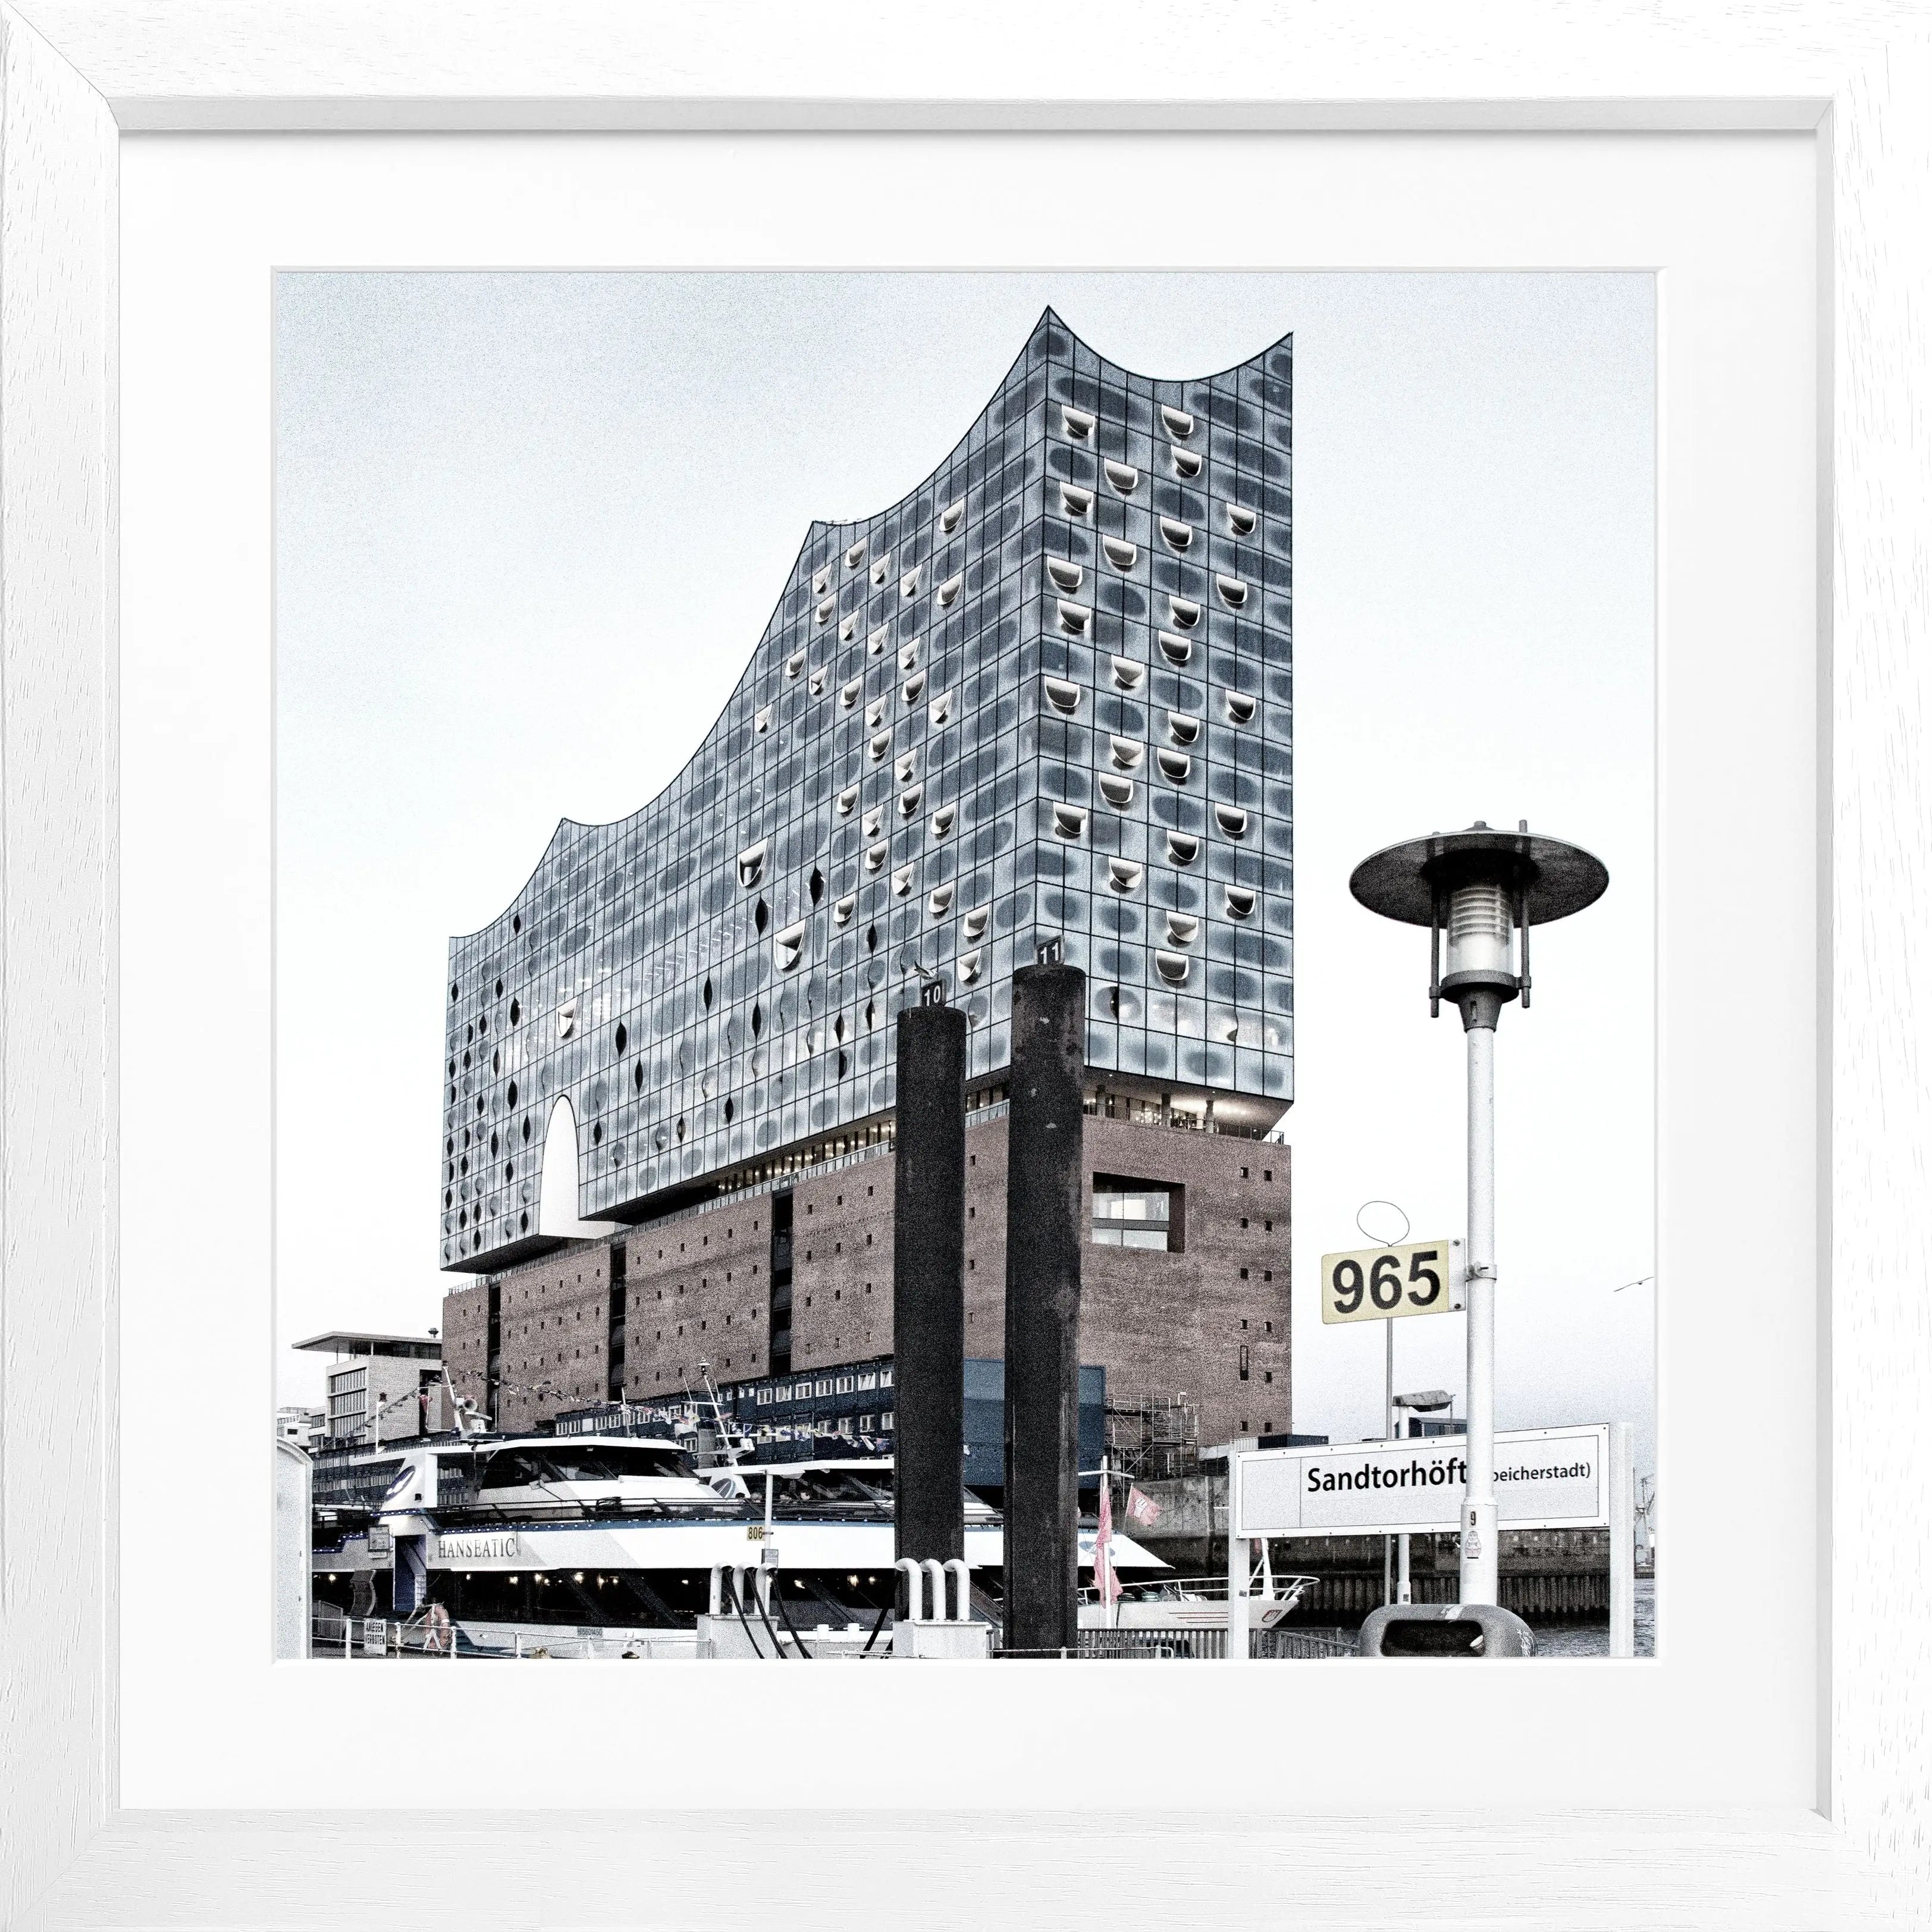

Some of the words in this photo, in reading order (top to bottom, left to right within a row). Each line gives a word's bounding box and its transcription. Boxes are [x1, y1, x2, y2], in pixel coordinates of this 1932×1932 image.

[1040, 942, 1059, 964] 11
[924, 985, 941, 1006] 10
[1332, 1250, 1441, 1315] 965
[1307, 1457, 1467, 1492] Sandtorhöft
[1470, 1511, 1476, 1526] 9
[748, 1526, 763, 1539] 806
[438, 1538, 515, 1558] HANSEATIC
